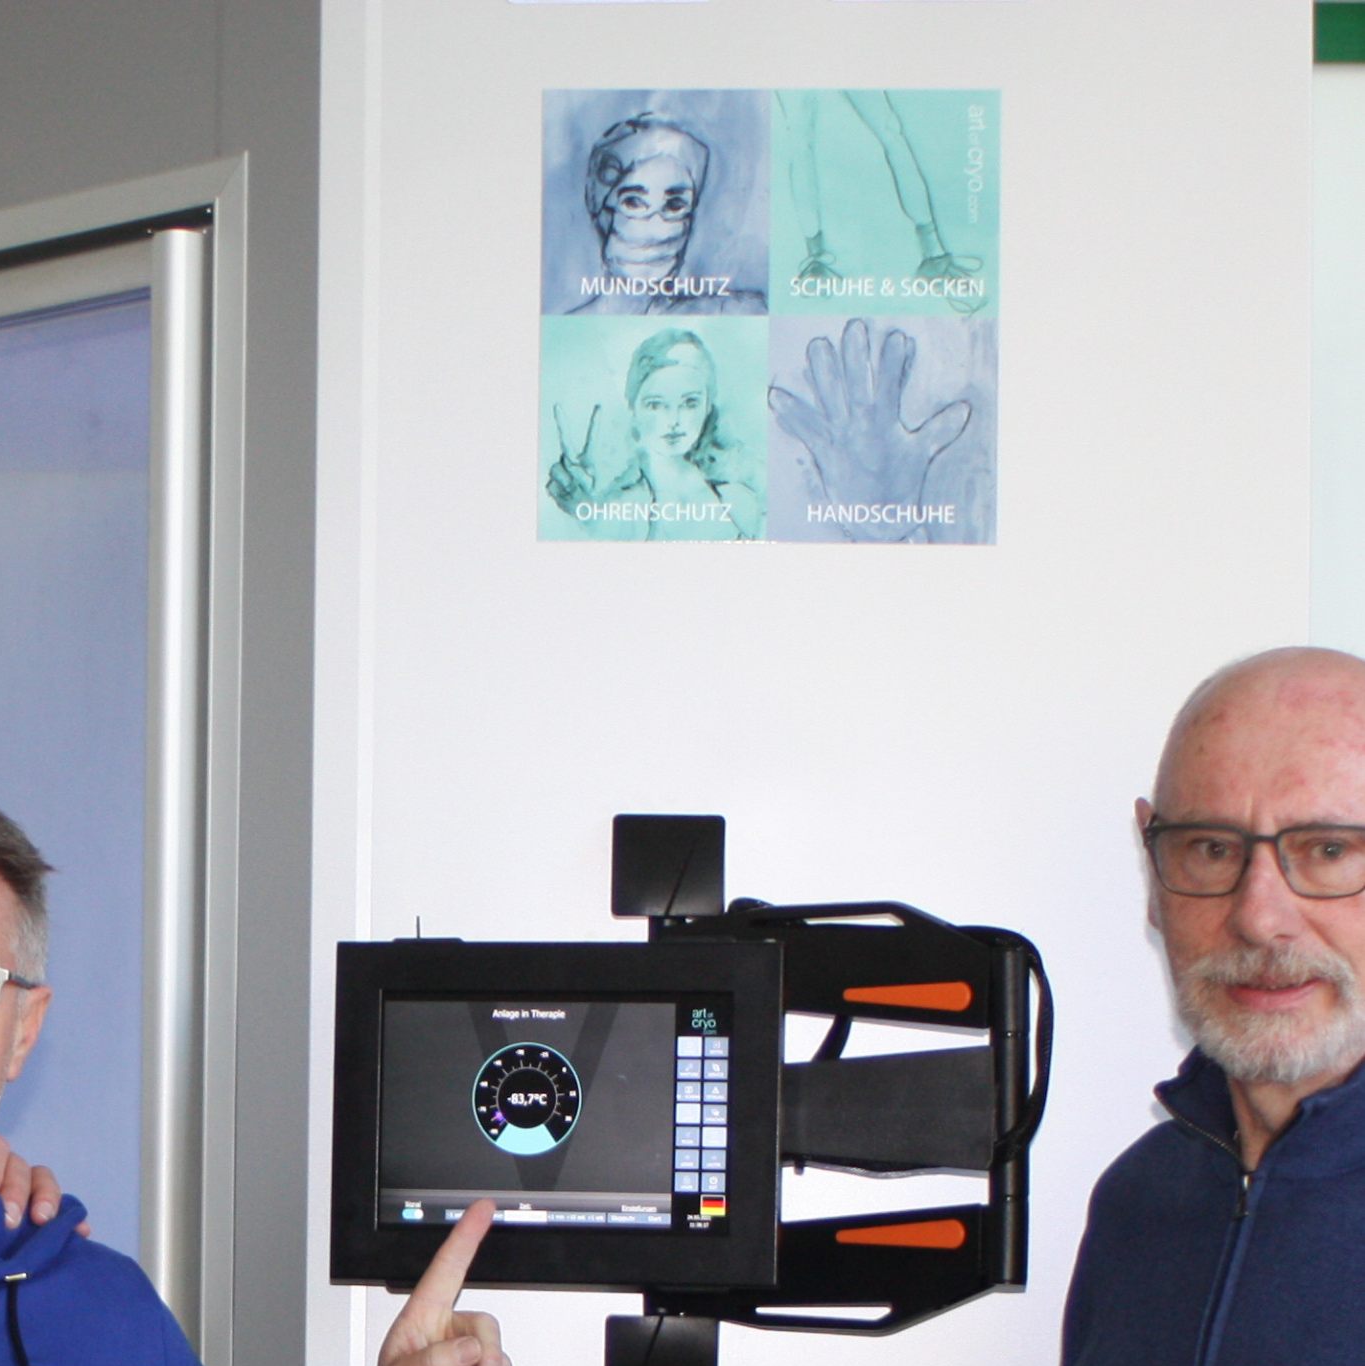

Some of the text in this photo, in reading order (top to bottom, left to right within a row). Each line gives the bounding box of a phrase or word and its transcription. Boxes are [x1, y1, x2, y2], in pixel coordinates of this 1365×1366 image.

[580, 276, 731, 297] MUNDSCHUTZ
[789, 277, 985, 298] SCHUHE & SOCKEN
[575, 502, 733, 523] OHRENSCHUTZ
[806, 503, 956, 524] HANDSCHUHE
[492, 1008, 520, 1020] Anlage
[531, 1008, 566, 1020] Therapie
[691, 1019, 716, 1031] cryo
